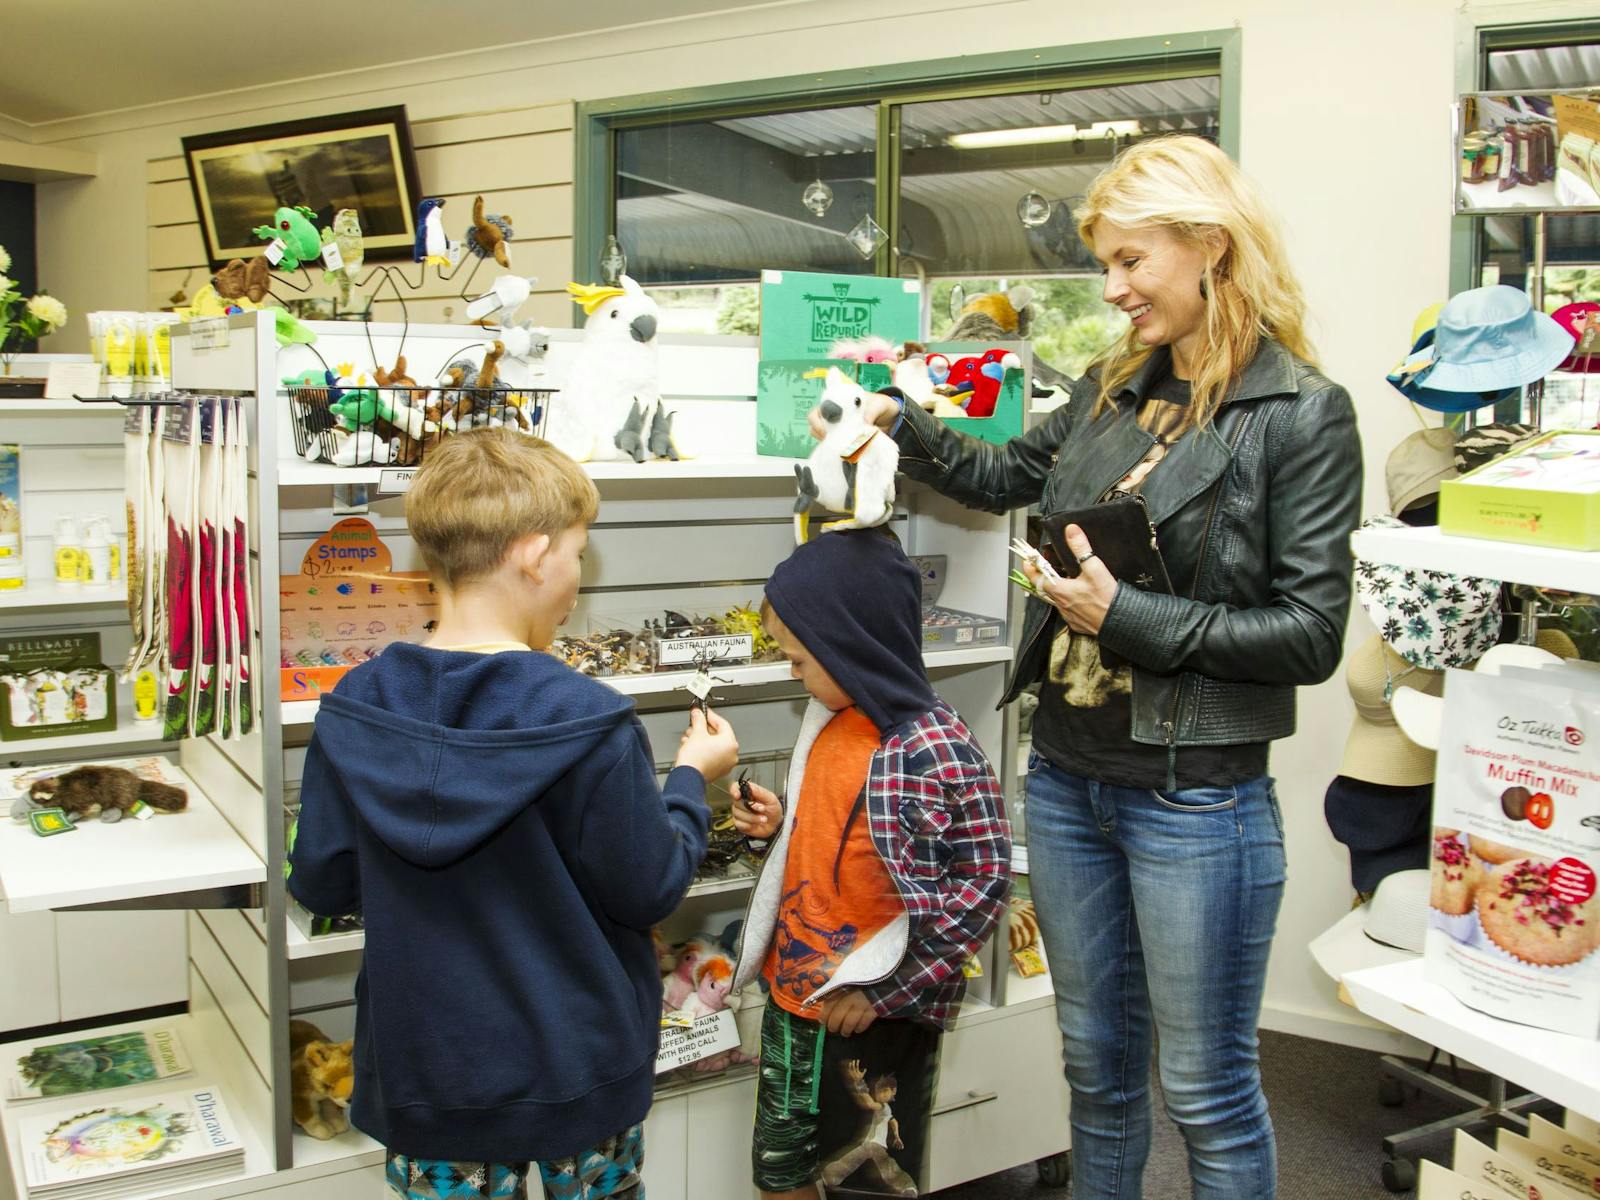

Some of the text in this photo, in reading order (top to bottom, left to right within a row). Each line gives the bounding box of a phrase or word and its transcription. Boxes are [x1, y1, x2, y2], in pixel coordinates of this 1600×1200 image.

[816, 306, 868, 323] WILD
[396, 472, 416, 481] FIN
[332, 529, 371, 542] Animal
[318, 545, 377, 562] Stamps
[667, 638, 747, 651] AUSTRALIAN FAUNA
[1497, 716, 1562, 740] Oz Tukka
[1464, 745, 1508, 761] Davidson
[1512, 754, 1535, 766] Plum
[1538, 760, 1586, 778] Macadamia
[1488, 763, 1579, 796] Muffin Mix
[660, 1015, 720, 1039] TRALIA FAUNA
[660, 1025, 719, 1050] UFFED ANIMALS
[657, 1036, 718, 1061] WITH BIRD CALL
[678, 1051, 702, 1065] $12.95
